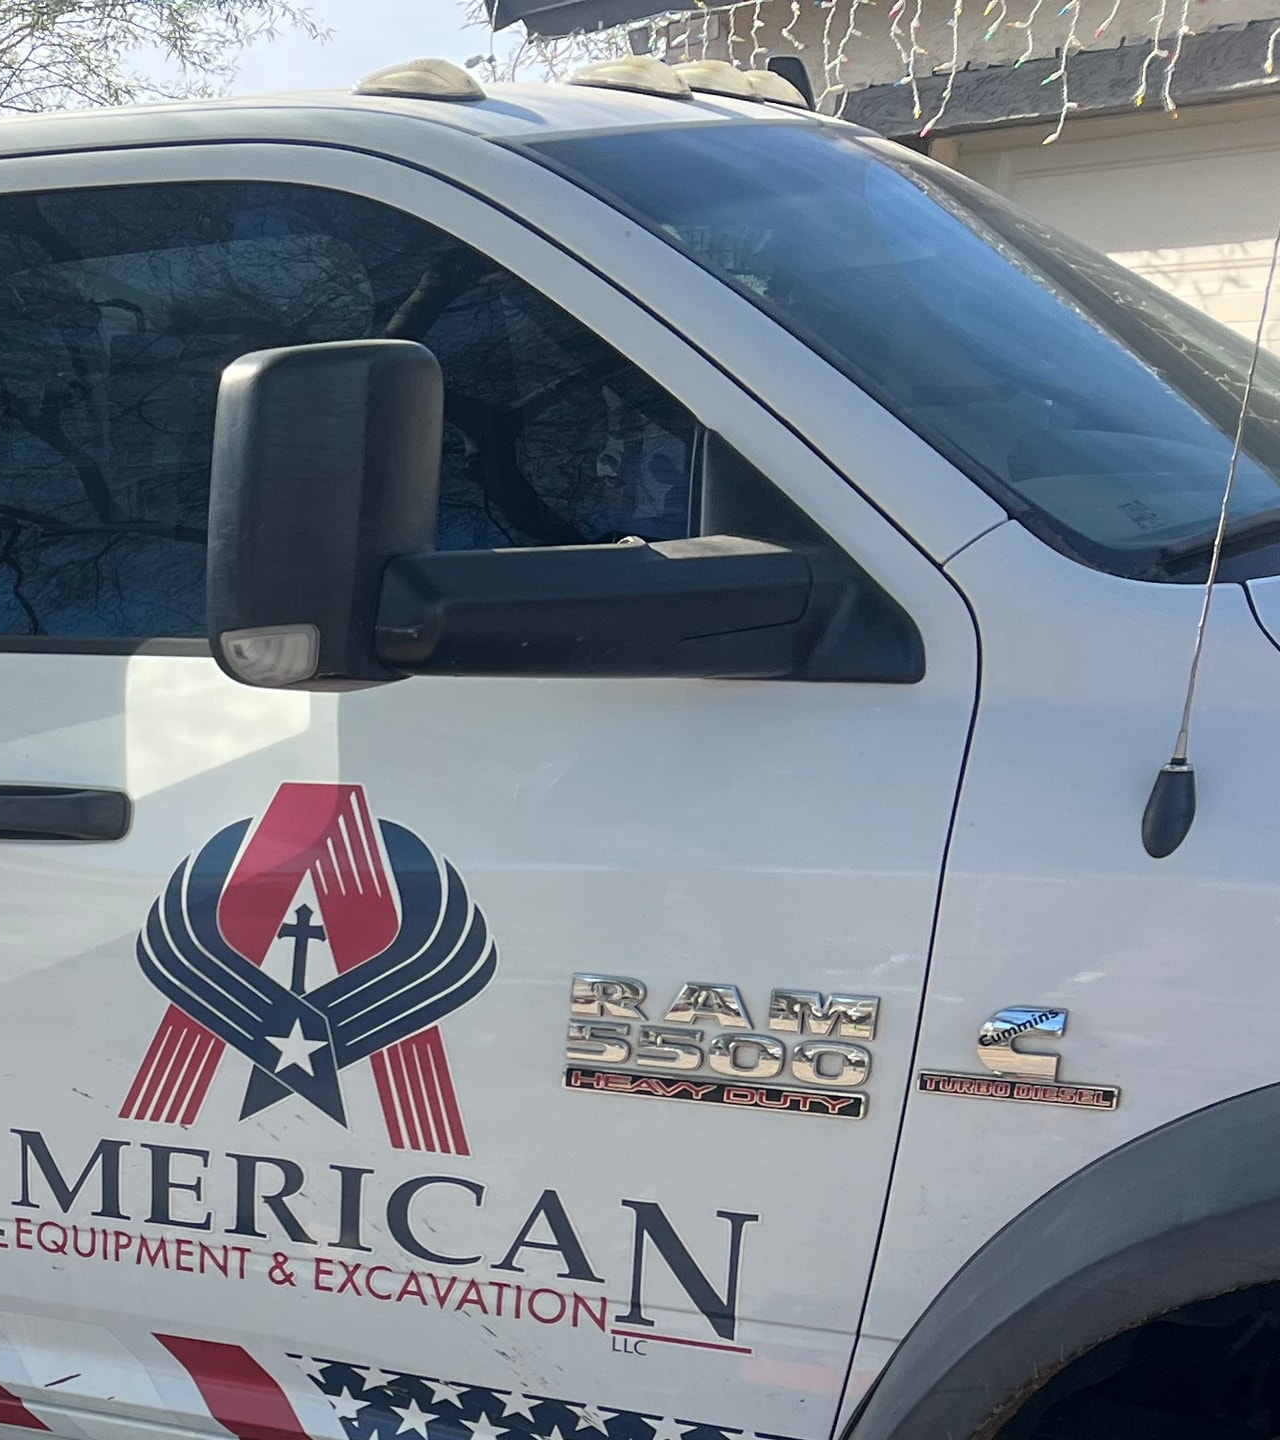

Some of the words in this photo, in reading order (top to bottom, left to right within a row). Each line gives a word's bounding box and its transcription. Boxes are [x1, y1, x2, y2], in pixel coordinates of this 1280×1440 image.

[570, 971, 882, 1042] RAM
[978, 1006, 1061, 1049] Cummins
[565, 1018, 874, 1088] 5500
[571, 1069, 720, 1100] HEAVY
[723, 1085, 857, 1115] DUTY
[923, 1074, 1012, 1099] TURBO
[1013, 1080, 1112, 1109] DIESEL
[15, 1217, 252, 1280] EQUIPMENT
[268, 1251, 298, 1287] &
[313, 1257, 608, 1333] EXCAVATION
[612, 1335, 648, 1356] LLC
